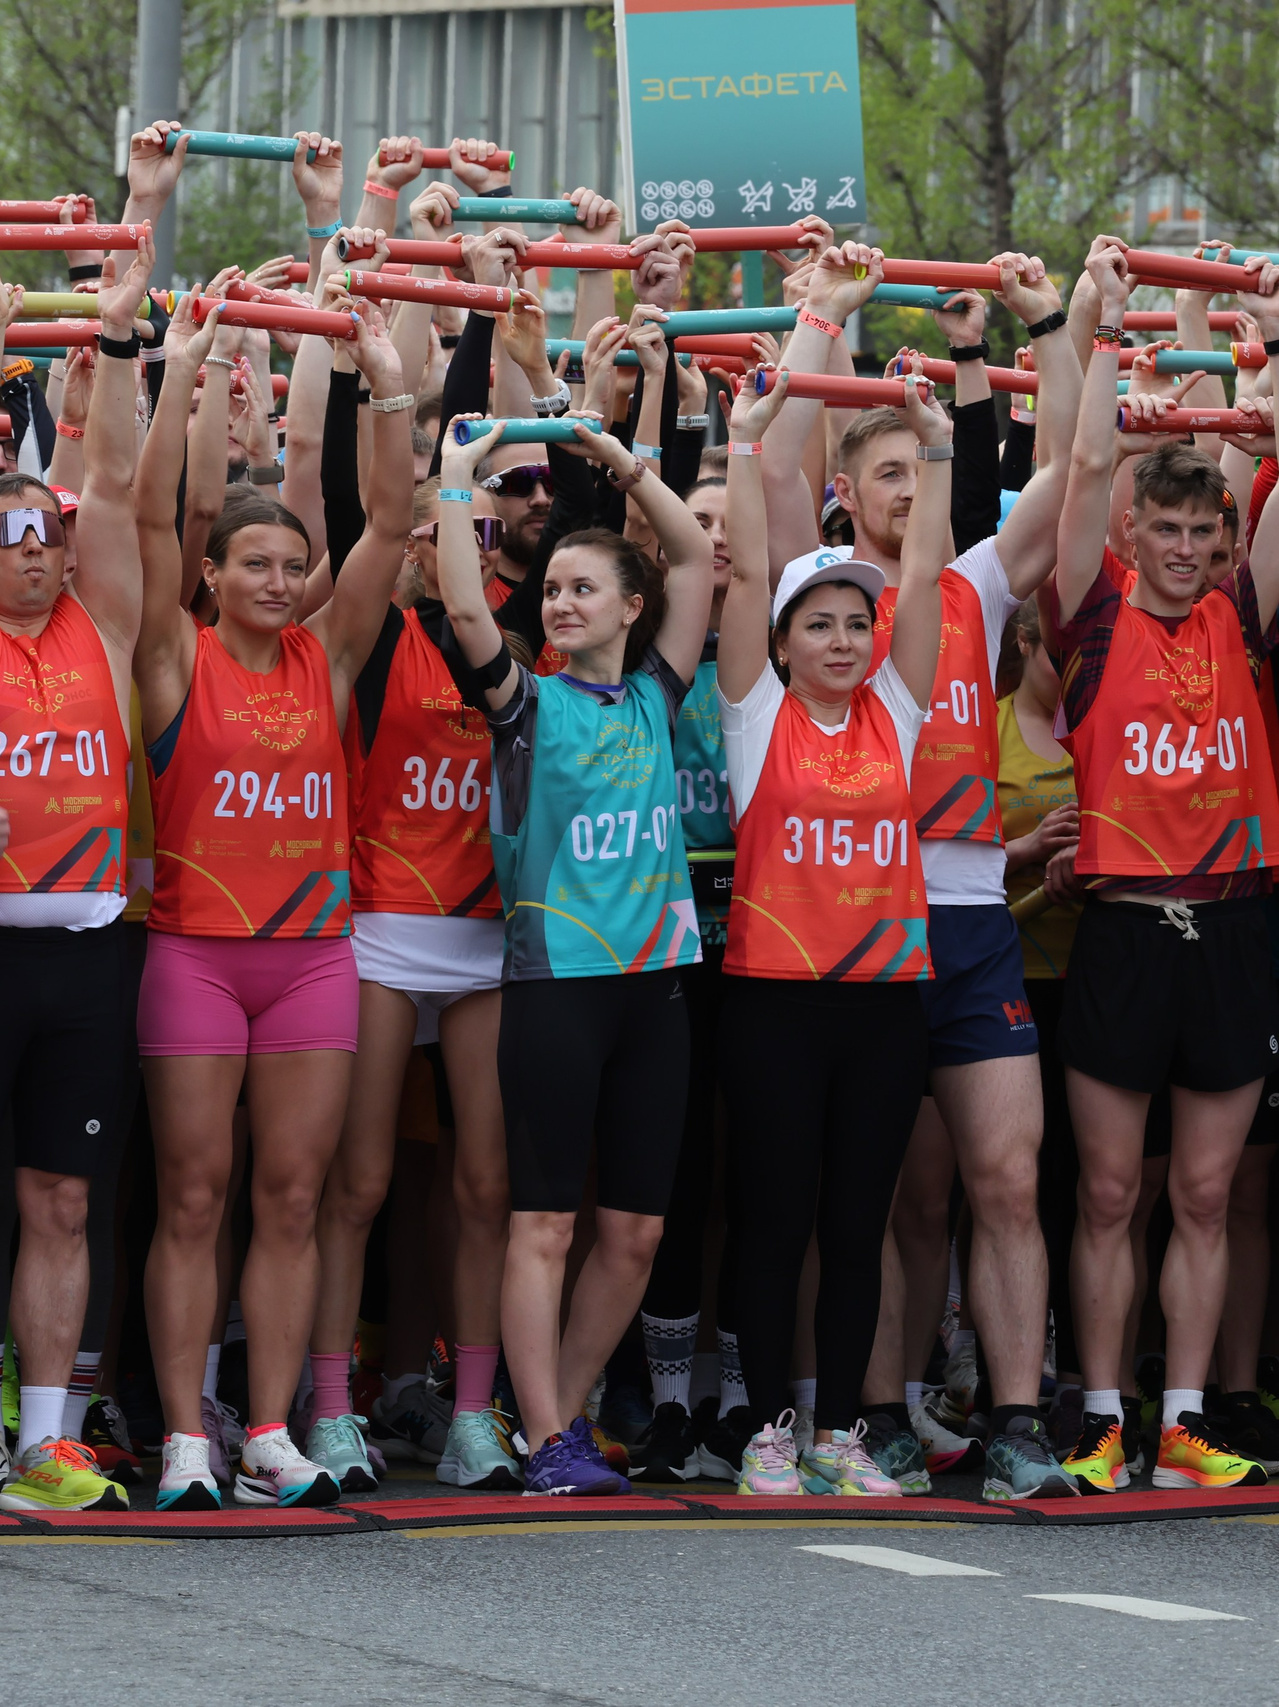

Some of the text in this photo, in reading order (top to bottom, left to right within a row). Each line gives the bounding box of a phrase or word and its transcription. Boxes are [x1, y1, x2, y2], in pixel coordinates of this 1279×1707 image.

[640, 70, 848, 102] ЭСТАФЕТА
[804, 312, 831, 332] 304-1
[250, 727, 308, 752] КОЛЬЦО
[1123, 715, 1249, 777] 364-01
[936, 743, 976, 754] МОСКОВСКИЙ
[936, 752, 957, 761] СПОРТ
[213, 769, 333, 820] 294-01
[822, 776, 881, 799] КОЛЬЦО
[62, 794, 103, 806] МОСКОВСКИЙ
[62, 804, 86, 815] СПОРТ
[570, 803, 677, 862] 027-01
[286, 838, 322, 850] МОСКОВСКИЙ
[782, 816, 908, 868] 315-01
[286, 848, 305, 858] СПОРТ
[854, 886, 893, 898] МОСКОВСКИЙ
[854, 896, 874, 906] СПОРТ
